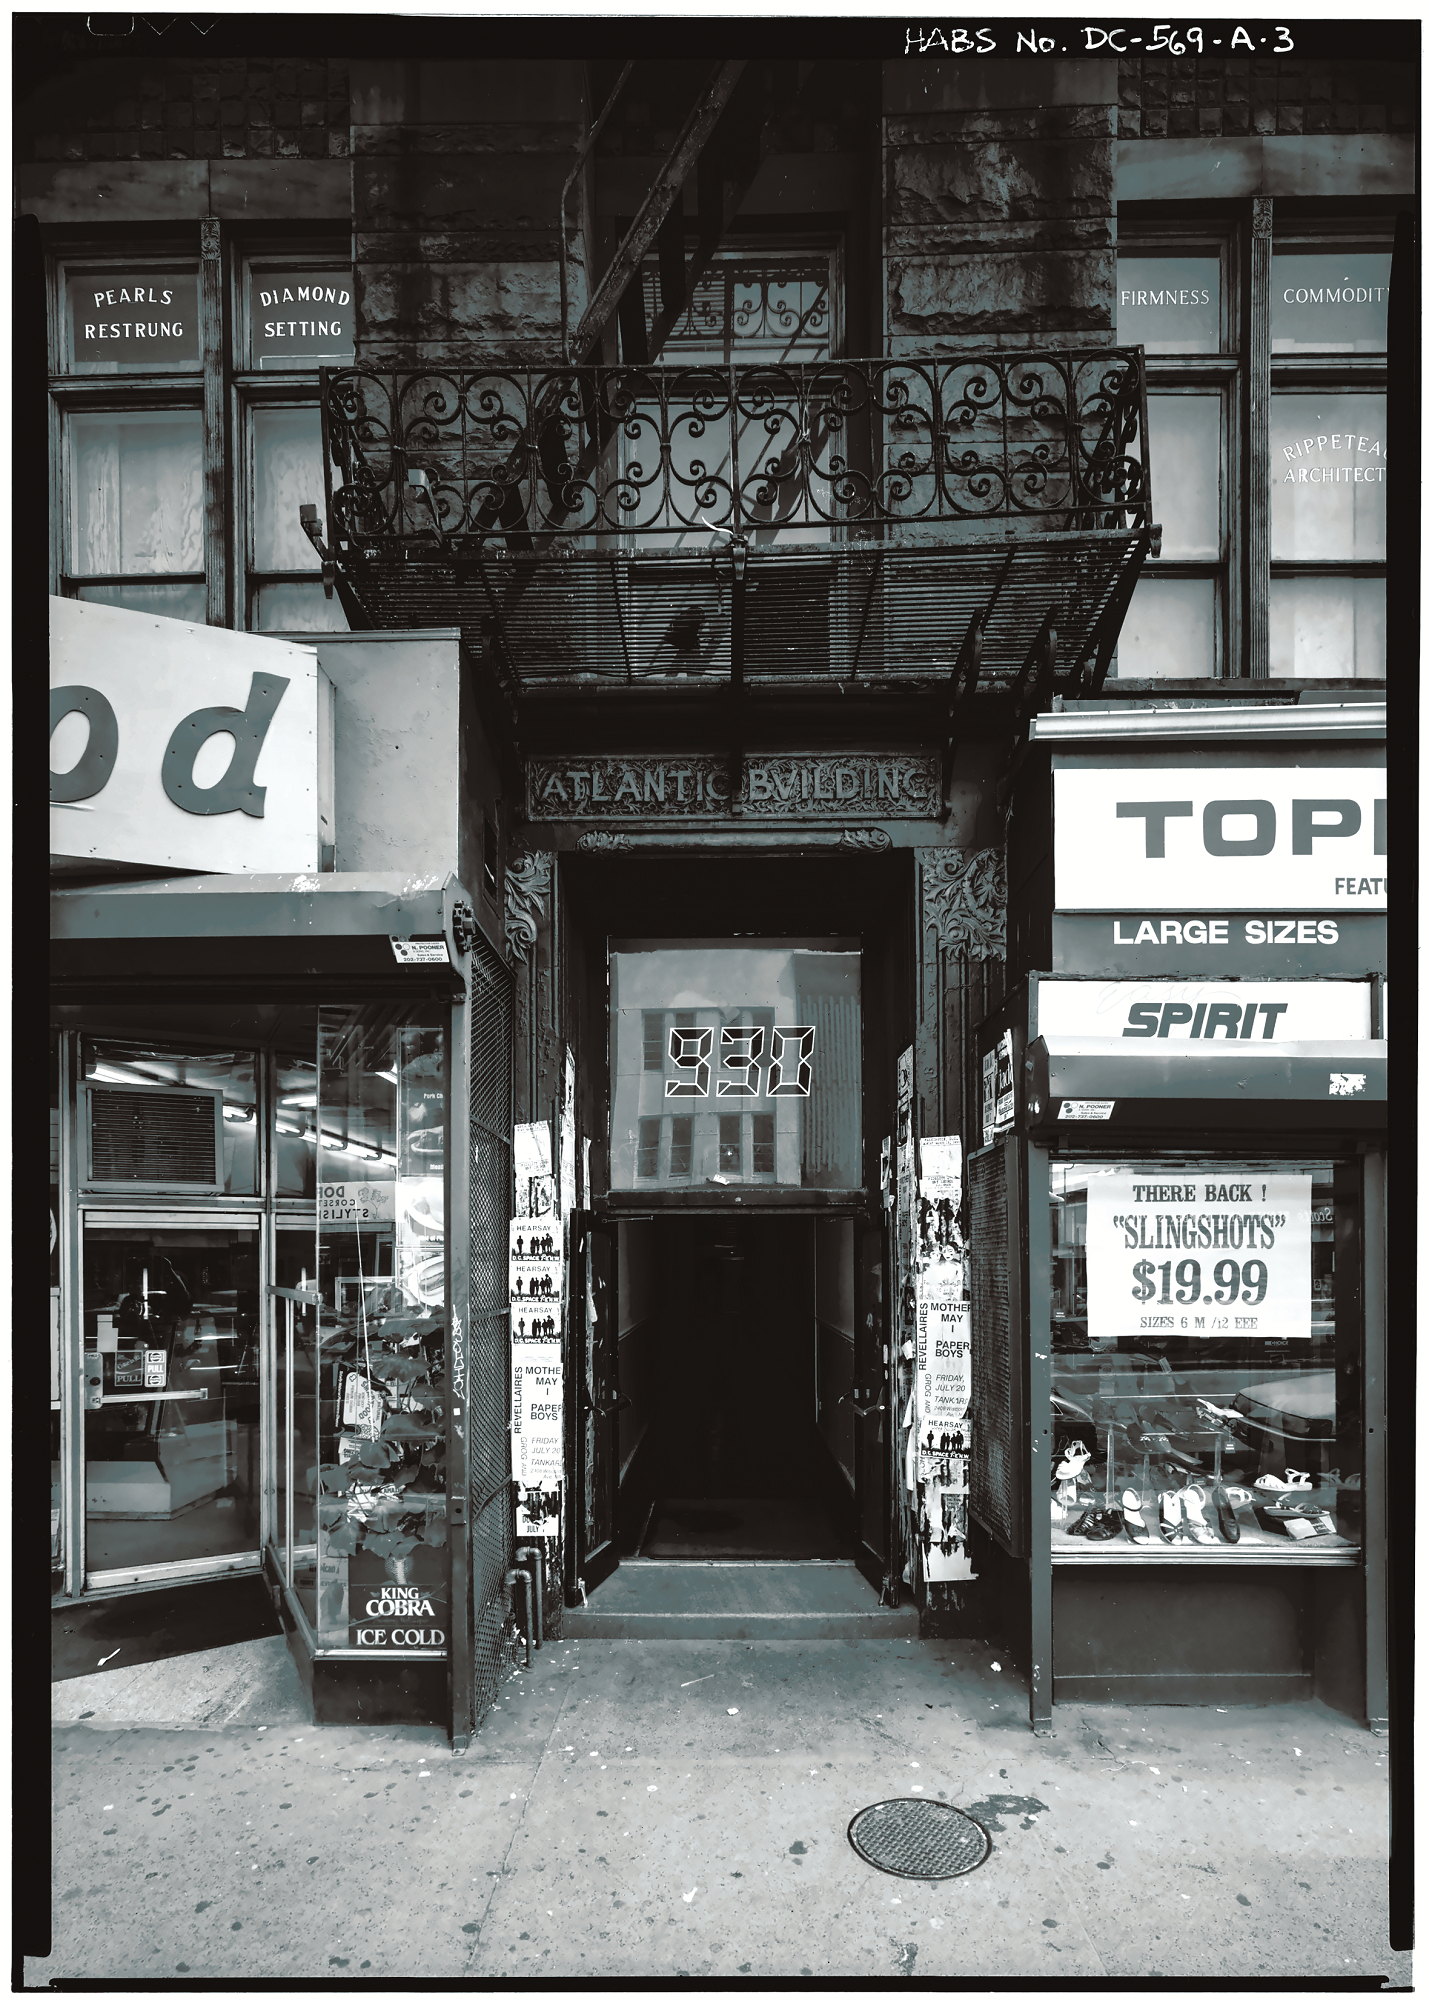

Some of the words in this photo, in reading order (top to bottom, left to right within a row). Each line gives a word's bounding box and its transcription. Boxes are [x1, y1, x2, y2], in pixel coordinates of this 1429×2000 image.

[94, 287, 173, 308] PEARLS
[259, 286, 351, 307] DIAMOND
[1121, 289, 1210, 306] FIRMNESS
[84, 322, 183, 339] RESTRUNG
[264, 321, 342, 338] SETTING
[1283, 467, 1386, 483] ARCHITECT
[540, 769, 732, 802] ATLANTIC
[1116, 799, 1387, 859] TOP
[1113, 921, 1229, 944] LARGE
[1245, 920, 1339, 945] SIZES
[1122, 1002, 1288, 1039] SPIRIT
[665, 1026, 816, 1097] 930
[1132, 1184, 1196, 1202] THERE
[1204, 1184, 1252, 1202] BACK
[1261, 1184, 1267, 1202] !
[1131, 1258, 1268, 1306] $19.99
[941, 1314, 963, 1323] MAY
[1140, 1316, 1174, 1328] SIZES
[1180, 1316, 1188, 1328] 6
[1194, 1316, 1205, 1328] M
[1234, 1317, 1258, 1329] EEE
[919, 1302, 928, 1370] REVELLAIRES
[951, 1325, 954, 1333] I
[936, 1340, 970, 1350] PAPER
[935, 1349, 963, 1358] BOYS
[147, 1364, 164, 1373] PULL
[117, 1374, 141, 1383] PULL
[535, 1377, 558, 1385] MAY
[936, 1374, 965, 1383] FRIDAY,
[935, 1384, 955, 1392] JULY
[955, 1384, 966, 1392] 20
[514, 1366, 523, 1434] REVELLAIRES
[530, 1412, 558, 1420] BOYS
[928, 1419, 963, 1429] HEARSAY
[381, 1587, 419, 1599] KING
[365, 1599, 435, 1616] COBRA
[356, 1629, 387, 1645] ICE
[391, 1629, 445, 1645] COLD
